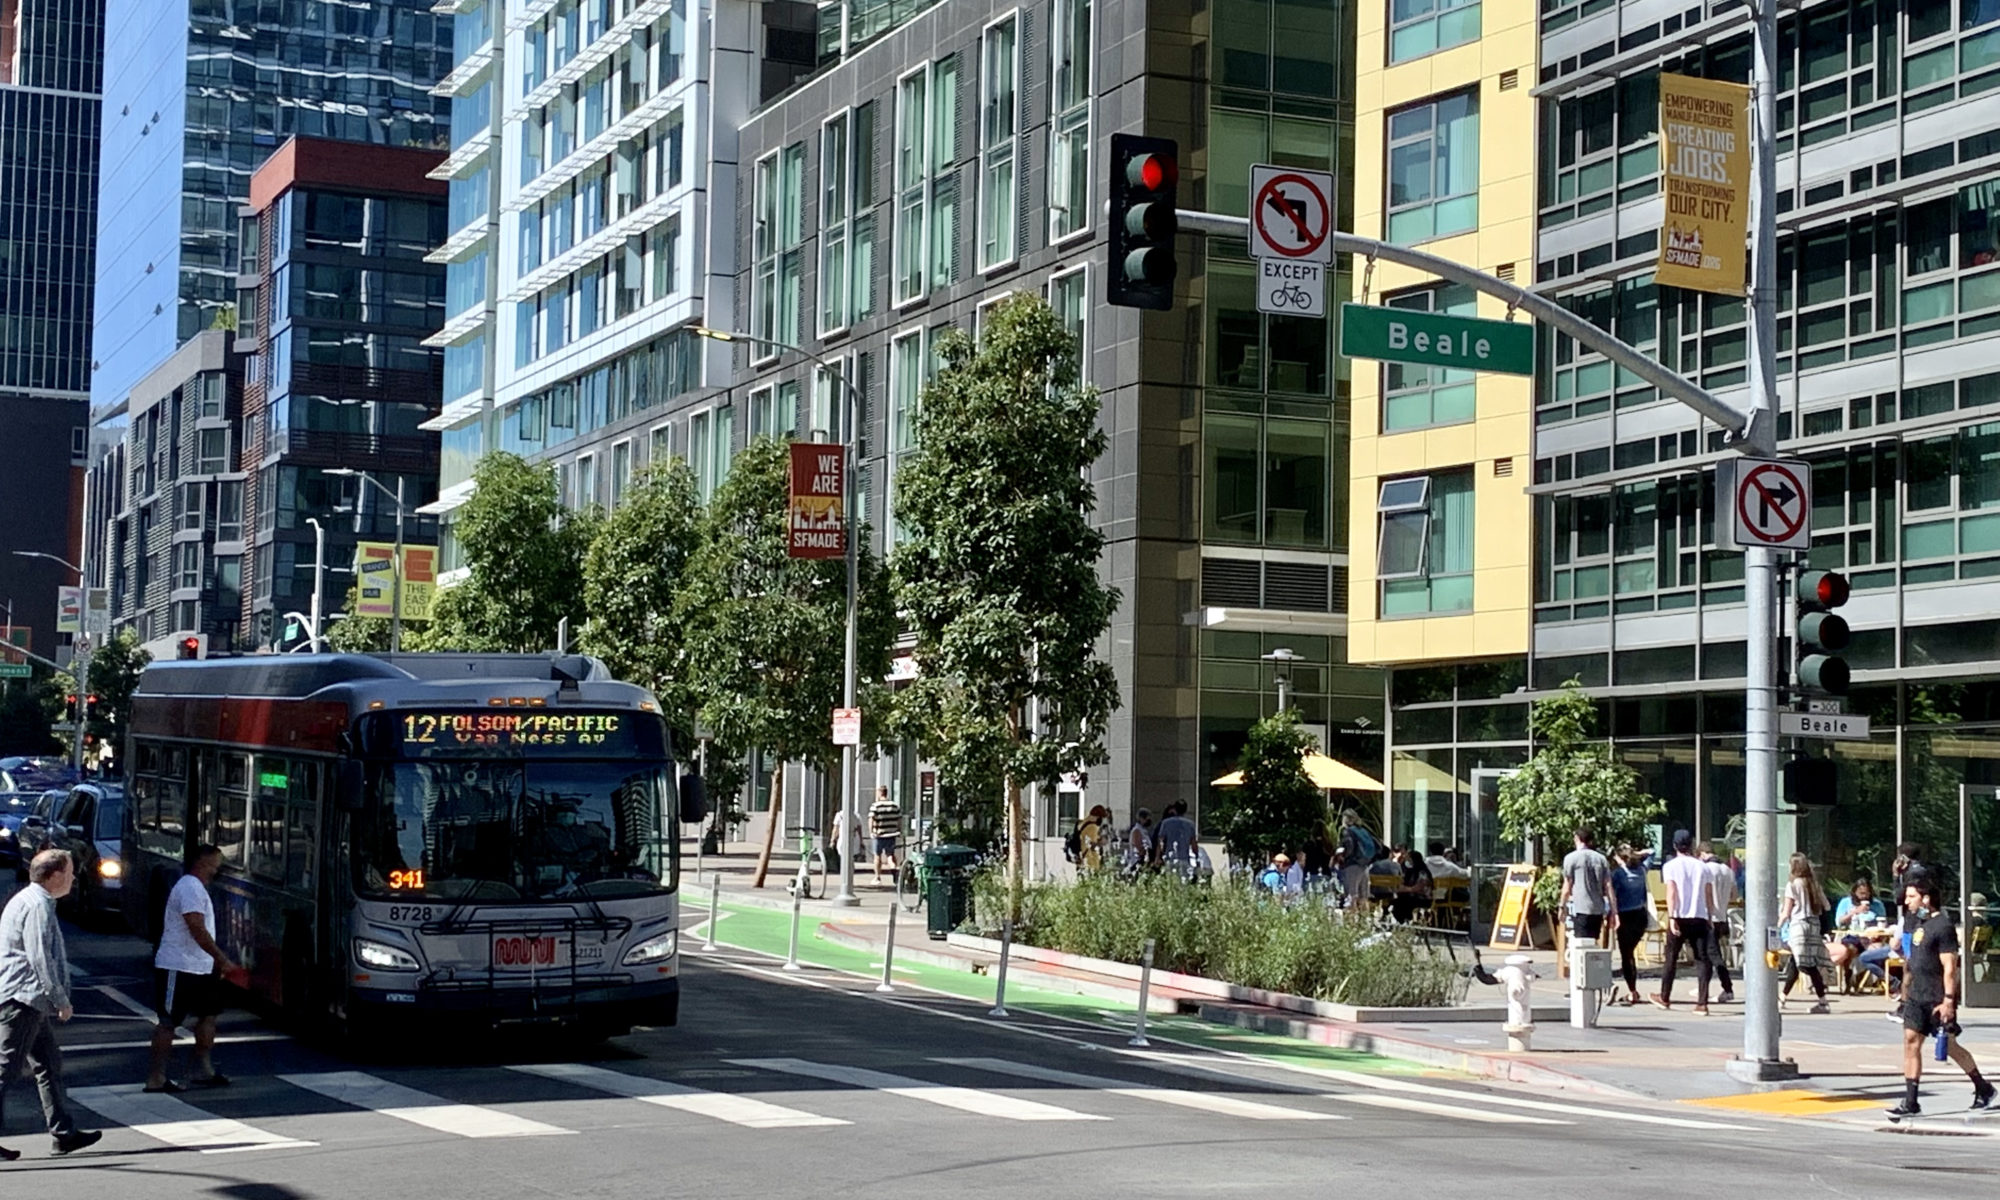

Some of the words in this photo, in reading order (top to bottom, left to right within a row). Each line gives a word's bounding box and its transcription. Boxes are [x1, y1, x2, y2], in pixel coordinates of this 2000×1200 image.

[1665, 93, 1734, 118] EMPOWERING
[1668, 123, 1735, 153] CREATING
[1670, 145, 1732, 184] JOBS.
[1669, 178, 1736, 203] TRANSFORMING
[1669, 193, 1698, 217] OUR
[1701, 198, 1735, 223] CITY.
[1264, 262, 1319, 282] EXCEPT
[1388, 321, 1491, 359] Beale
[817, 454, 840, 474] WE
[811, 474, 840, 494] ARE
[793, 532, 840, 549] SFMADE
[405, 583, 427, 594] THE
[404, 605, 427, 616] CUT
[1820, 701, 1838, 712] 300
[403, 715, 437, 743] 12
[440, 715, 619, 732] FOLSOM/PACIFIC
[1801, 717, 1848, 733] Beale
[455, 732, 499, 745] Van
[510, 732, 567, 745] Ness
[578, 732, 606, 744] Av
[389, 869, 425, 889] 341
[389, 906, 433, 921] 8728
